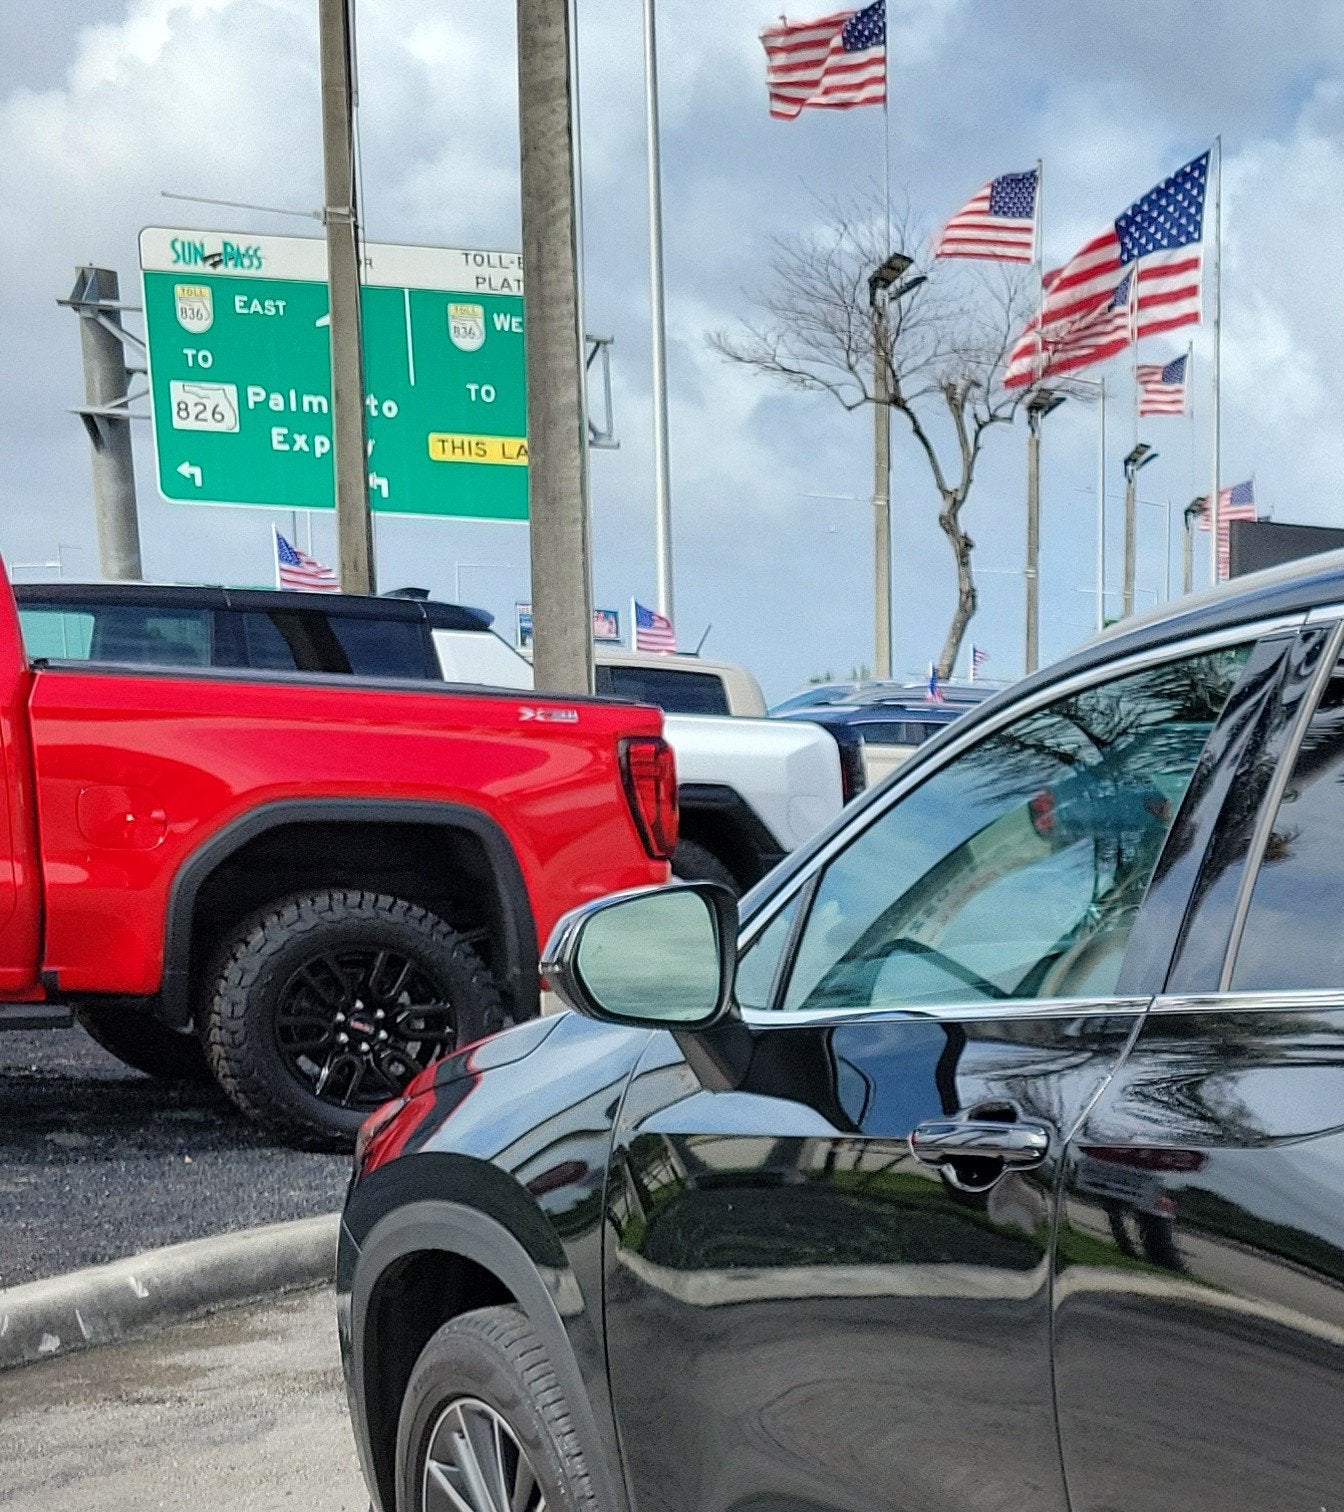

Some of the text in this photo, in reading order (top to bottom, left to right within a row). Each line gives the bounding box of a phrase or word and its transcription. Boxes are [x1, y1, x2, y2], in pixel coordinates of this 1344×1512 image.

[475, 276, 523, 293] PLAT
[180, 306, 204, 322] 836
[234, 295, 287, 317] EAST
[492, 312, 524, 333] WE
[183, 348, 213, 369] TO
[247, 385, 399, 418] Palmto
[466, 383, 496, 403] TO
[176, 400, 226, 423] 826
[437, 438, 529, 461] THIS LA
